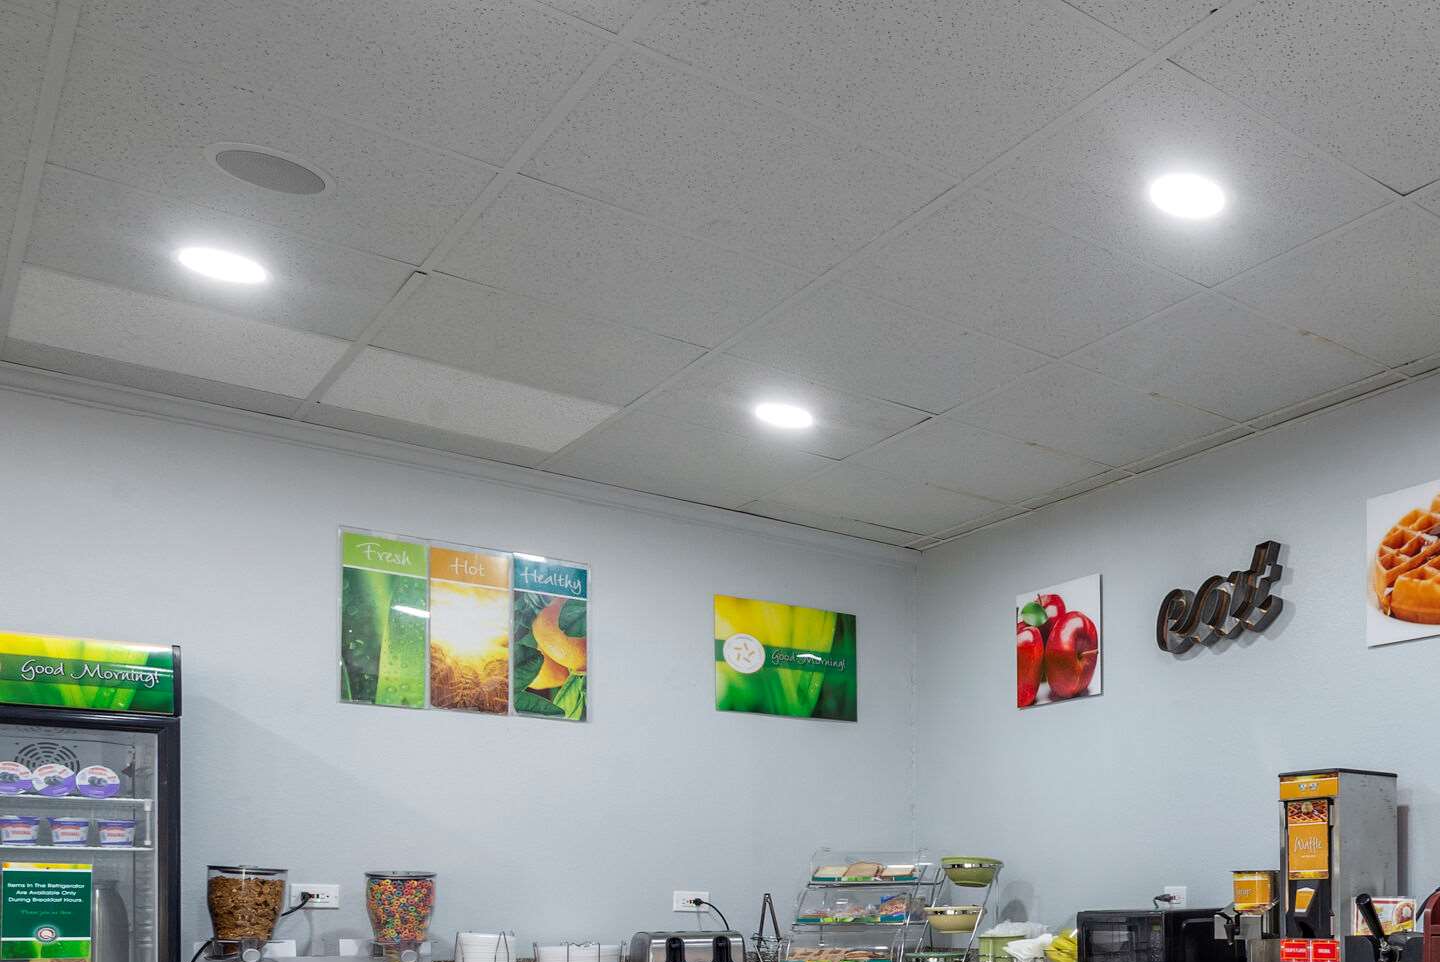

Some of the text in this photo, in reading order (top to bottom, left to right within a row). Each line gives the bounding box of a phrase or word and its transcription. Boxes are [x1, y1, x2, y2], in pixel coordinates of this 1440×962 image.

[355, 542, 412, 567] Fresh
[450, 557, 486, 577] Hot
[519, 567, 583, 595] Healthy
[1156, 540, 1284, 655] eat
[771, 649, 796, 665] Good
[20, 659, 161, 689] Good Morning!
